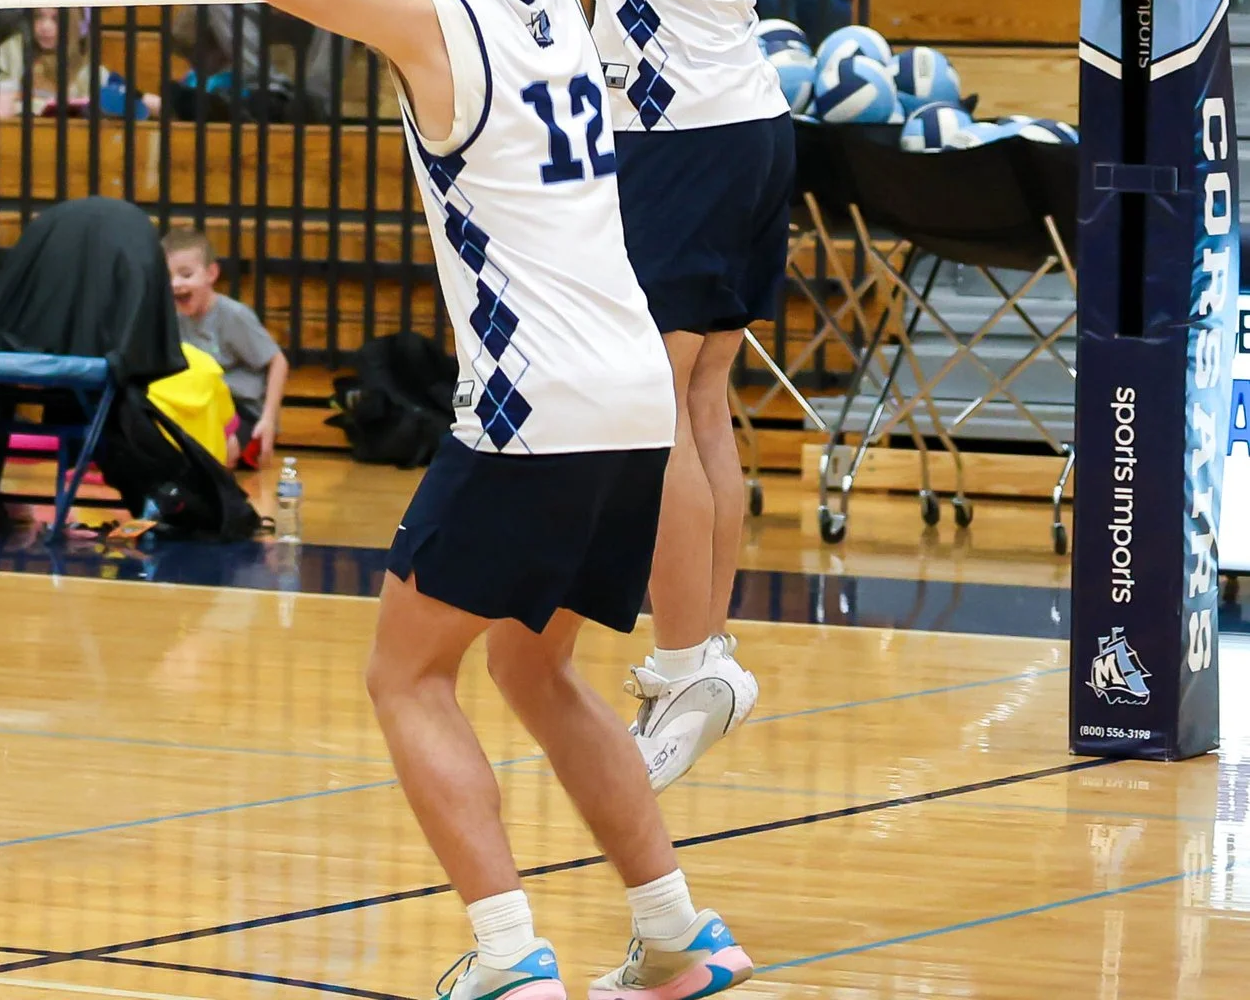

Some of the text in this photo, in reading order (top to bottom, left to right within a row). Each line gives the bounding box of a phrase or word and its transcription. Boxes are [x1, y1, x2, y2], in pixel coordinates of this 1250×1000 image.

[520, 72, 617, 186] 12
[1107, 386, 1138, 604] sports imports
[1079, 725, 1151, 740] (800) 556-3198
